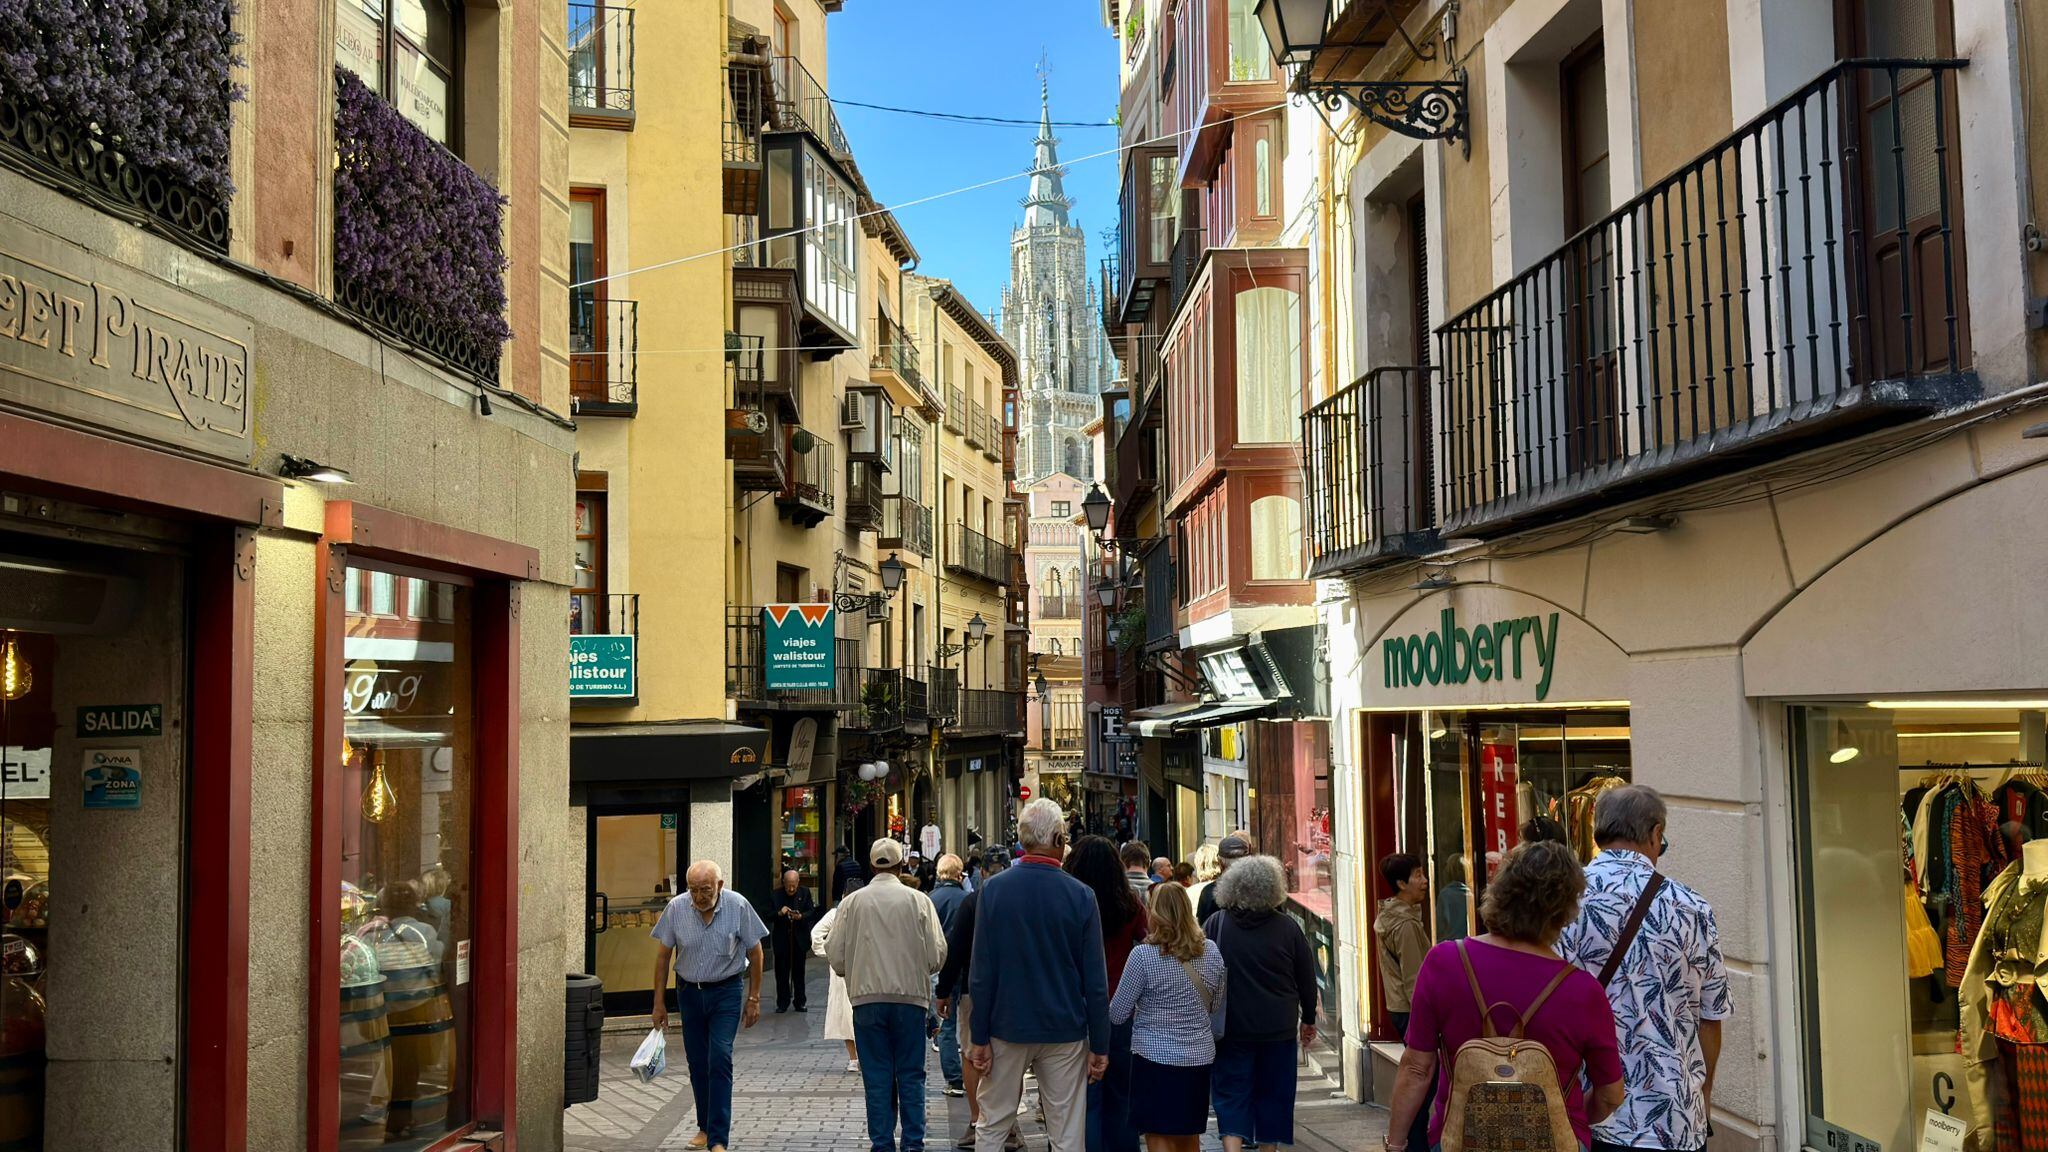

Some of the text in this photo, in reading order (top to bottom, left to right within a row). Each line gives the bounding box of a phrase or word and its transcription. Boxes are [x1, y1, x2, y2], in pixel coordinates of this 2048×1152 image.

[89, 281, 243, 430] PIRATE
[783, 637, 816, 649] viajes
[570, 649, 598, 665] jes
[773, 651, 826, 661] walistour
[1383, 607, 1559, 701] moolberry
[570, 665, 627, 679] listour
[84, 710, 154, 731] SALIDA
[105, 780, 136, 789] ZONA
[1929, 1118, 1960, 1136] moolberry
